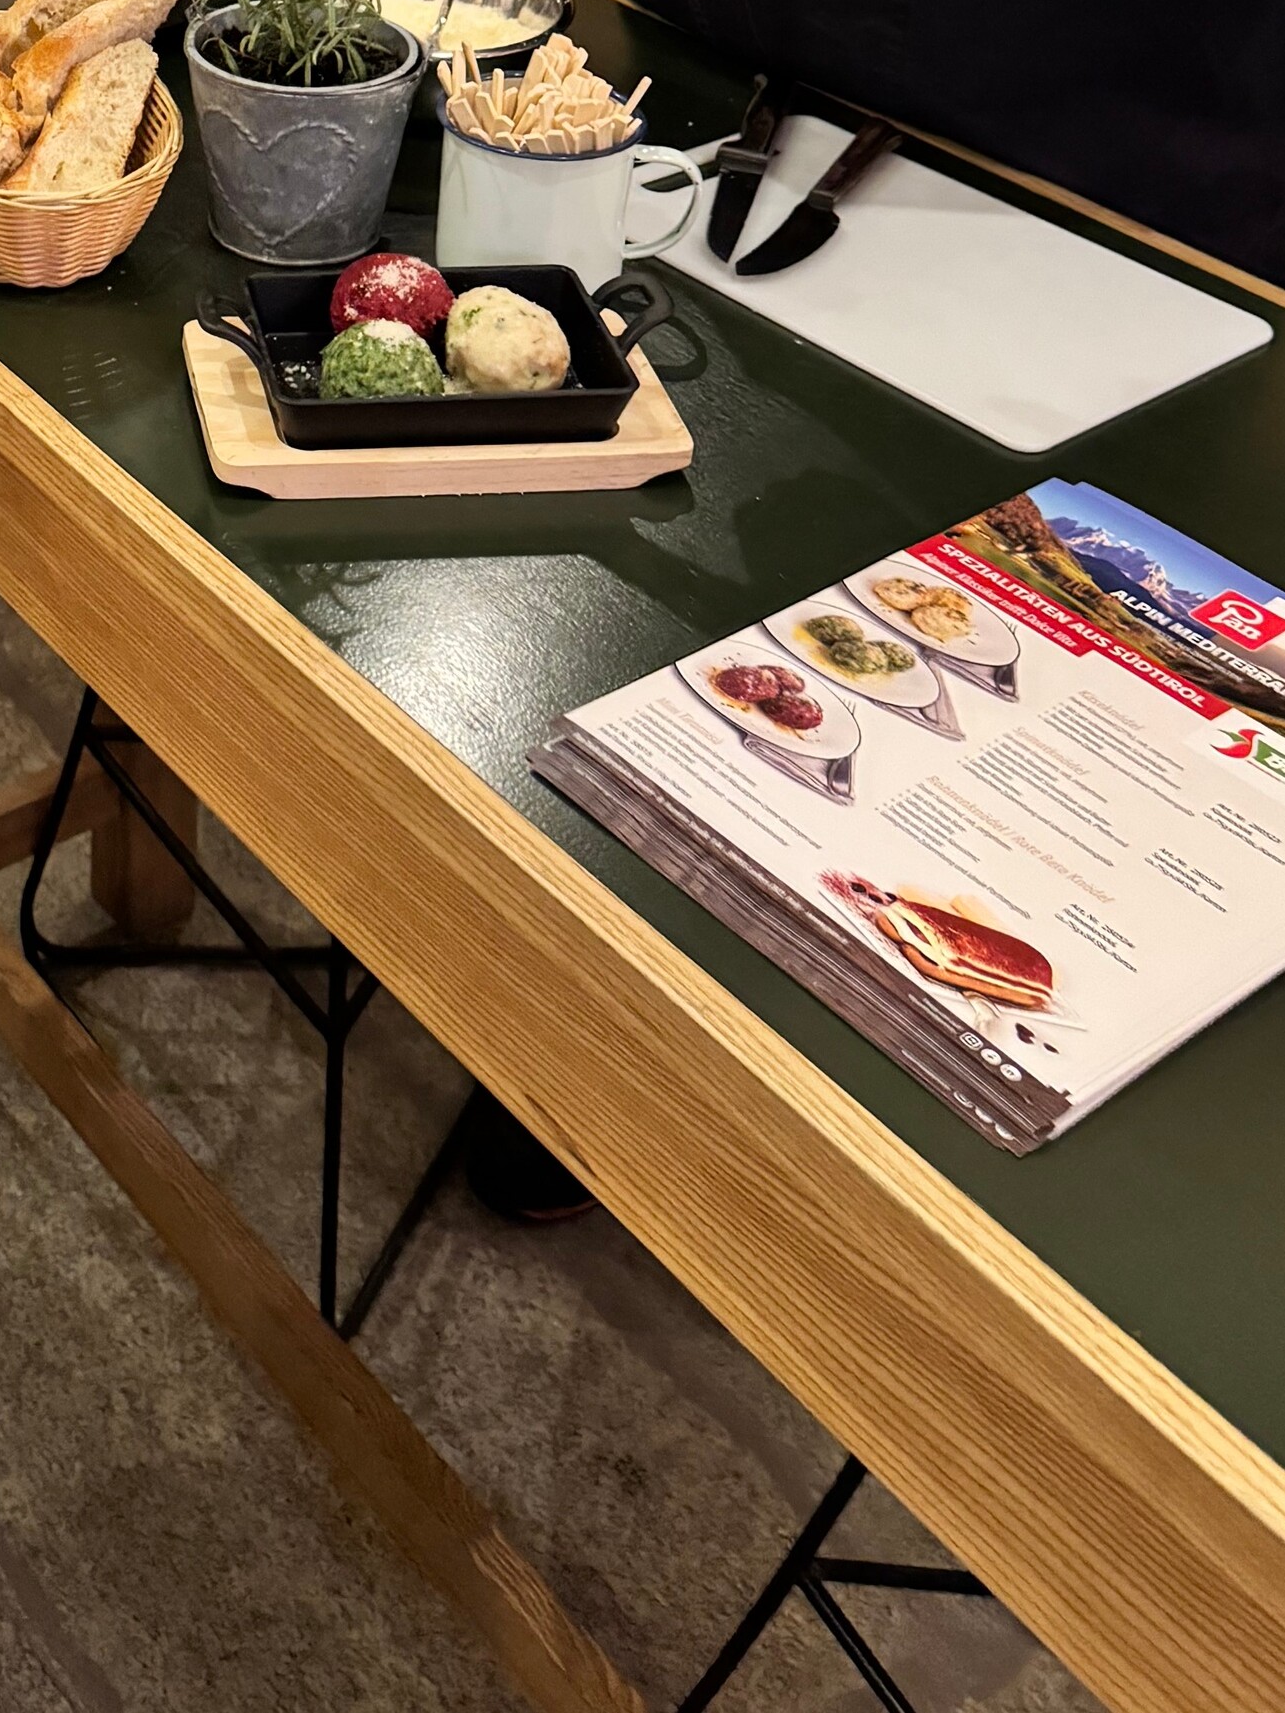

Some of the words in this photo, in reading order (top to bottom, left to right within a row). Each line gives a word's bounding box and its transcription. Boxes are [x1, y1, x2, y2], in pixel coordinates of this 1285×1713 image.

[935, 541, 1075, 624] SPEZIALITÄTEN
[1066, 620, 1113, 648] AUS
[1106, 643, 1214, 707] SÜDTIROL
[1108, 588, 1174, 625] ALPIN
[1208, 600, 1264, 640] Pan
